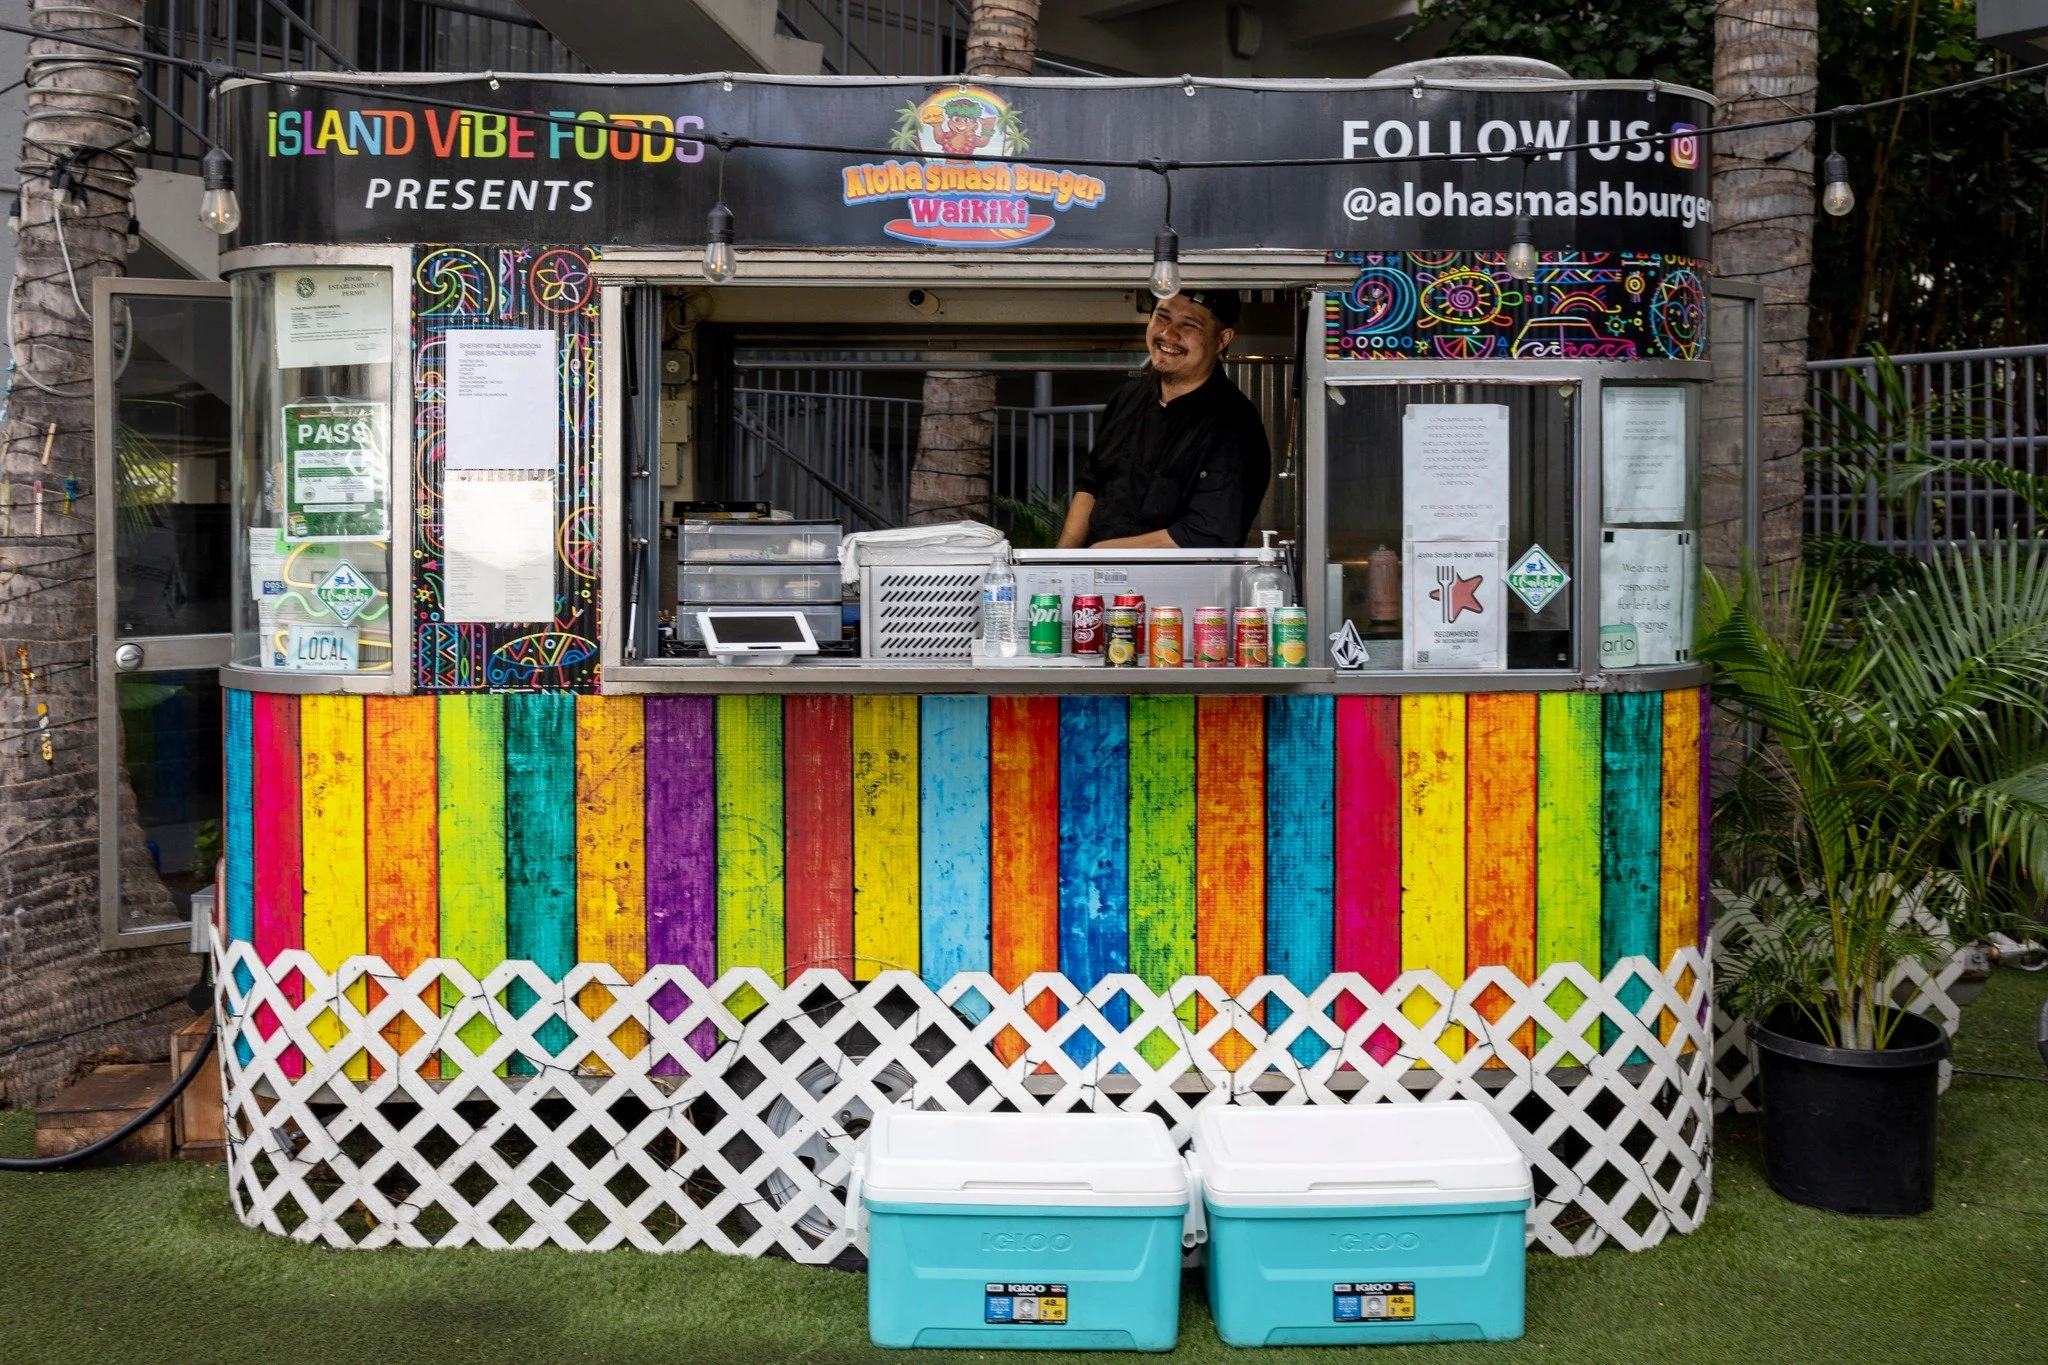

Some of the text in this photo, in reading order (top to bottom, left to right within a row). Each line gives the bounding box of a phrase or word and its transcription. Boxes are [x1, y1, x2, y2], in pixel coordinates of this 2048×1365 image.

[549, 110, 706, 164] FOODS
[1342, 120, 1666, 163] FOLLOW US:
[844, 161, 924, 199] Aloha
[1013, 166, 1105, 206] Burger
[364, 177, 595, 213] PRESENTS
[911, 198, 1028, 225] Waikiki
[327, 283, 380, 291] ESTABLISHMENT
[298, 422, 368, 445] PASS
[1454, 552, 1474, 560] Burger
[1434, 630, 1479, 638] RECOMMENDED
[1602, 634, 1635, 652] arlo
[298, 636, 348, 660] LOCAL
[981, 1232, 1074, 1252] IGLOO
[1328, 1231, 1420, 1252] IGLOO
[1008, 1284, 1046, 1293] IGLOO
[1355, 1283, 1394, 1292] IGLOO
